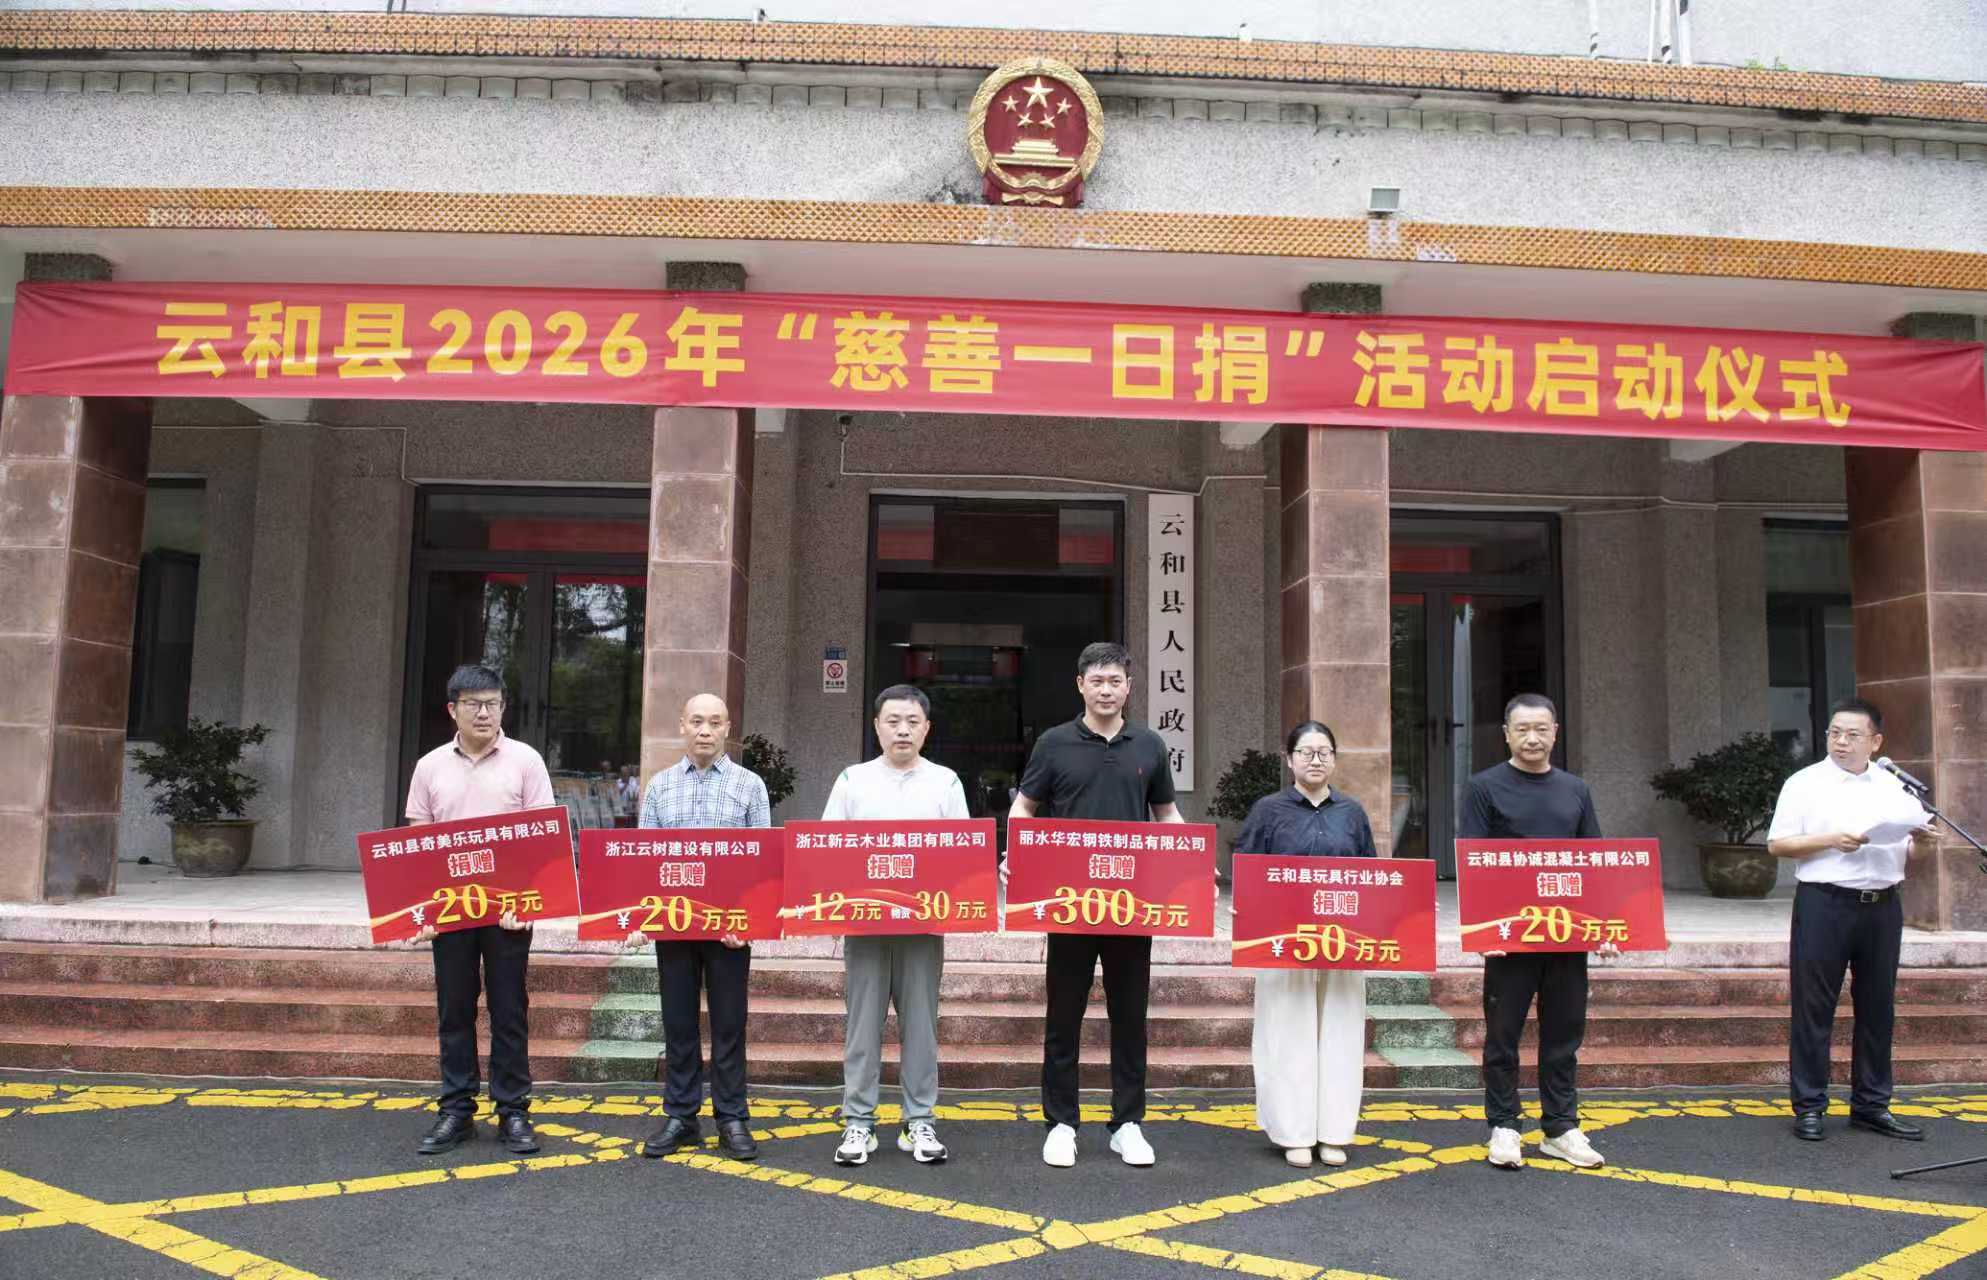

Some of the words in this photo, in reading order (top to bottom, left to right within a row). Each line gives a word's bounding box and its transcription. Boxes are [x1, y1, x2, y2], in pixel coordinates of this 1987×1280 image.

[1158, 514, 1185, 773] 云和县人民政府
[371, 820, 560, 859] 云和县奇美乐玩具有限公司
[606, 841, 760, 856] 浙江云树建设有限公司
[796, 832, 985, 848] 浙江新云木业集团有限公司
[1019, 830, 1205, 851] 丽水华宏钢铁制品有限公司
[448, 849, 495, 878] 捐赠
[868, 854, 914, 879] 捐赠
[1089, 854, 1135, 879] 捐赠
[1467, 851, 1649, 867] 云和县协诚混凝土有限公司
[660, 862, 705, 887] 捐赠
[1267, 868, 1403, 885] 云和县玩具行业协会
[1537, 872, 1582, 897] 捐赠
[1314, 890, 1358, 915] 捐赠
